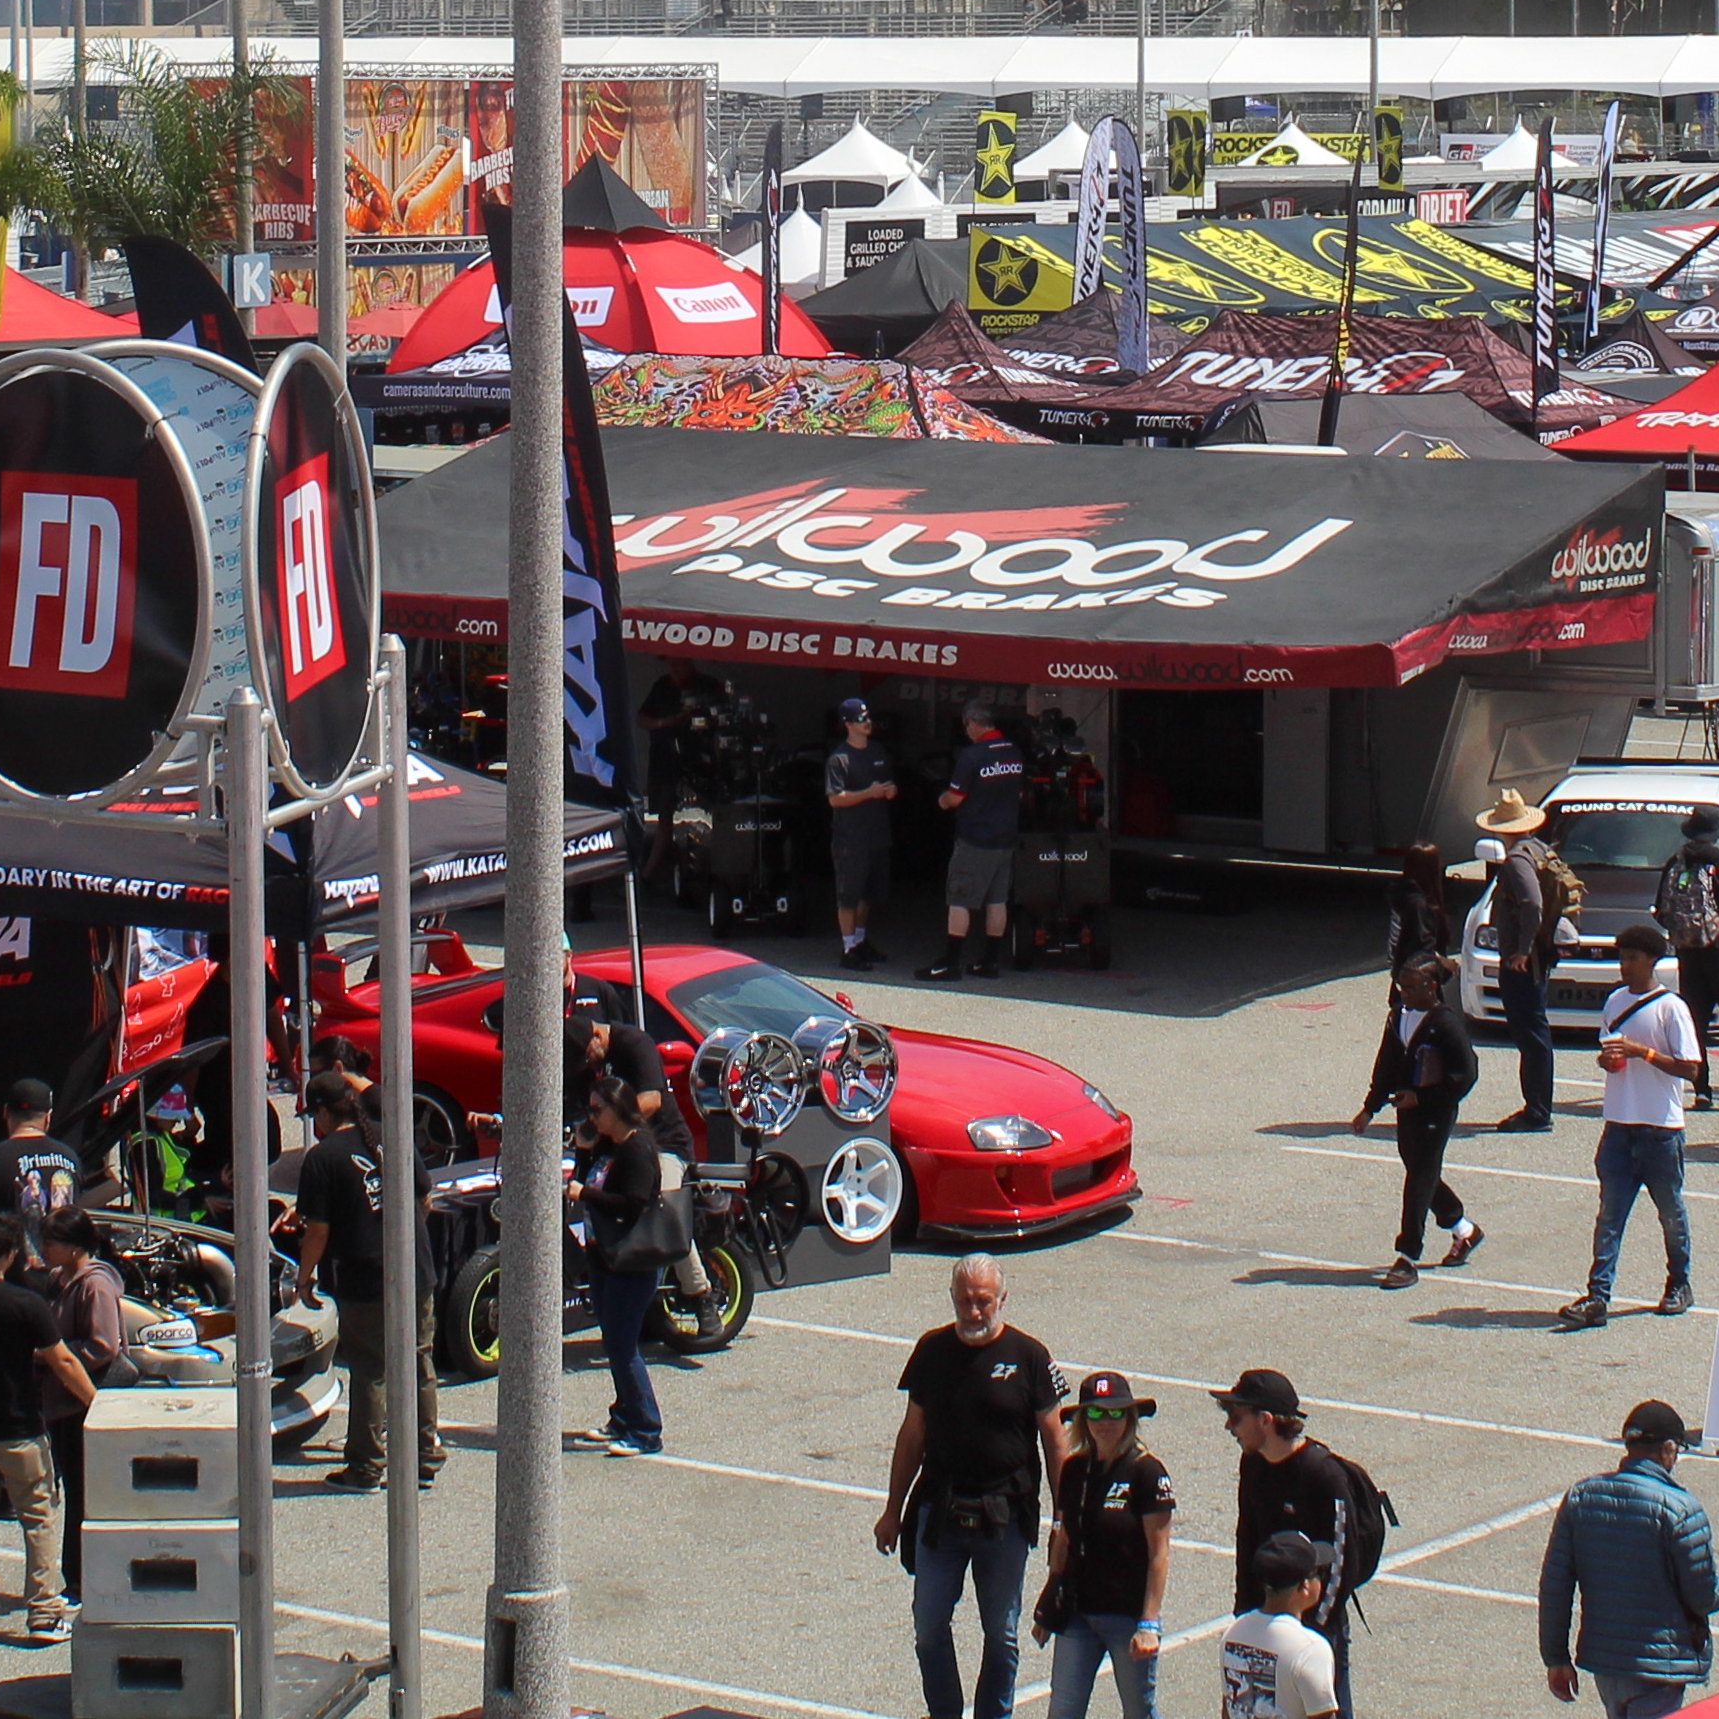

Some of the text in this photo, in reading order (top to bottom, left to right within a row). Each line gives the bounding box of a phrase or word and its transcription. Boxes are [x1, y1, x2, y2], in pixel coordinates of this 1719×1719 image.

[253, 202, 312, 225] ARBECUE
[1419, 191, 1467, 224] DRIFT
[263, 220, 294, 241] RIBS
[868, 229, 904, 241] LOADED
[850, 242, 888, 254] GRILLED
[242, 260, 264, 301] K
[672, 294, 741, 315] Canon
[981, 314, 1040, 327] ROCKSTAR
[1551, 527, 1651, 578] wilwood
[8, 491, 121, 674] FD
[283, 479, 335, 676] FD
[674, 554, 1227, 611] DISC BRAKES
[1579, 573, 1646, 593] DISC BRAKES
[622, 619, 957, 666] LWOOD DISC BRAKES
[1561, 802, 1644, 813] ROUND CAT
[50, 869, 70, 890] IN
[72, 872, 109, 895] THE
[111, 876, 151, 898] ART
[154, 882, 185, 901] OF
[18, 1152, 76, 1177] Primitive
[146, 1326, 193, 1343] sparco
[991, 1362, 1018, 1381] 27
